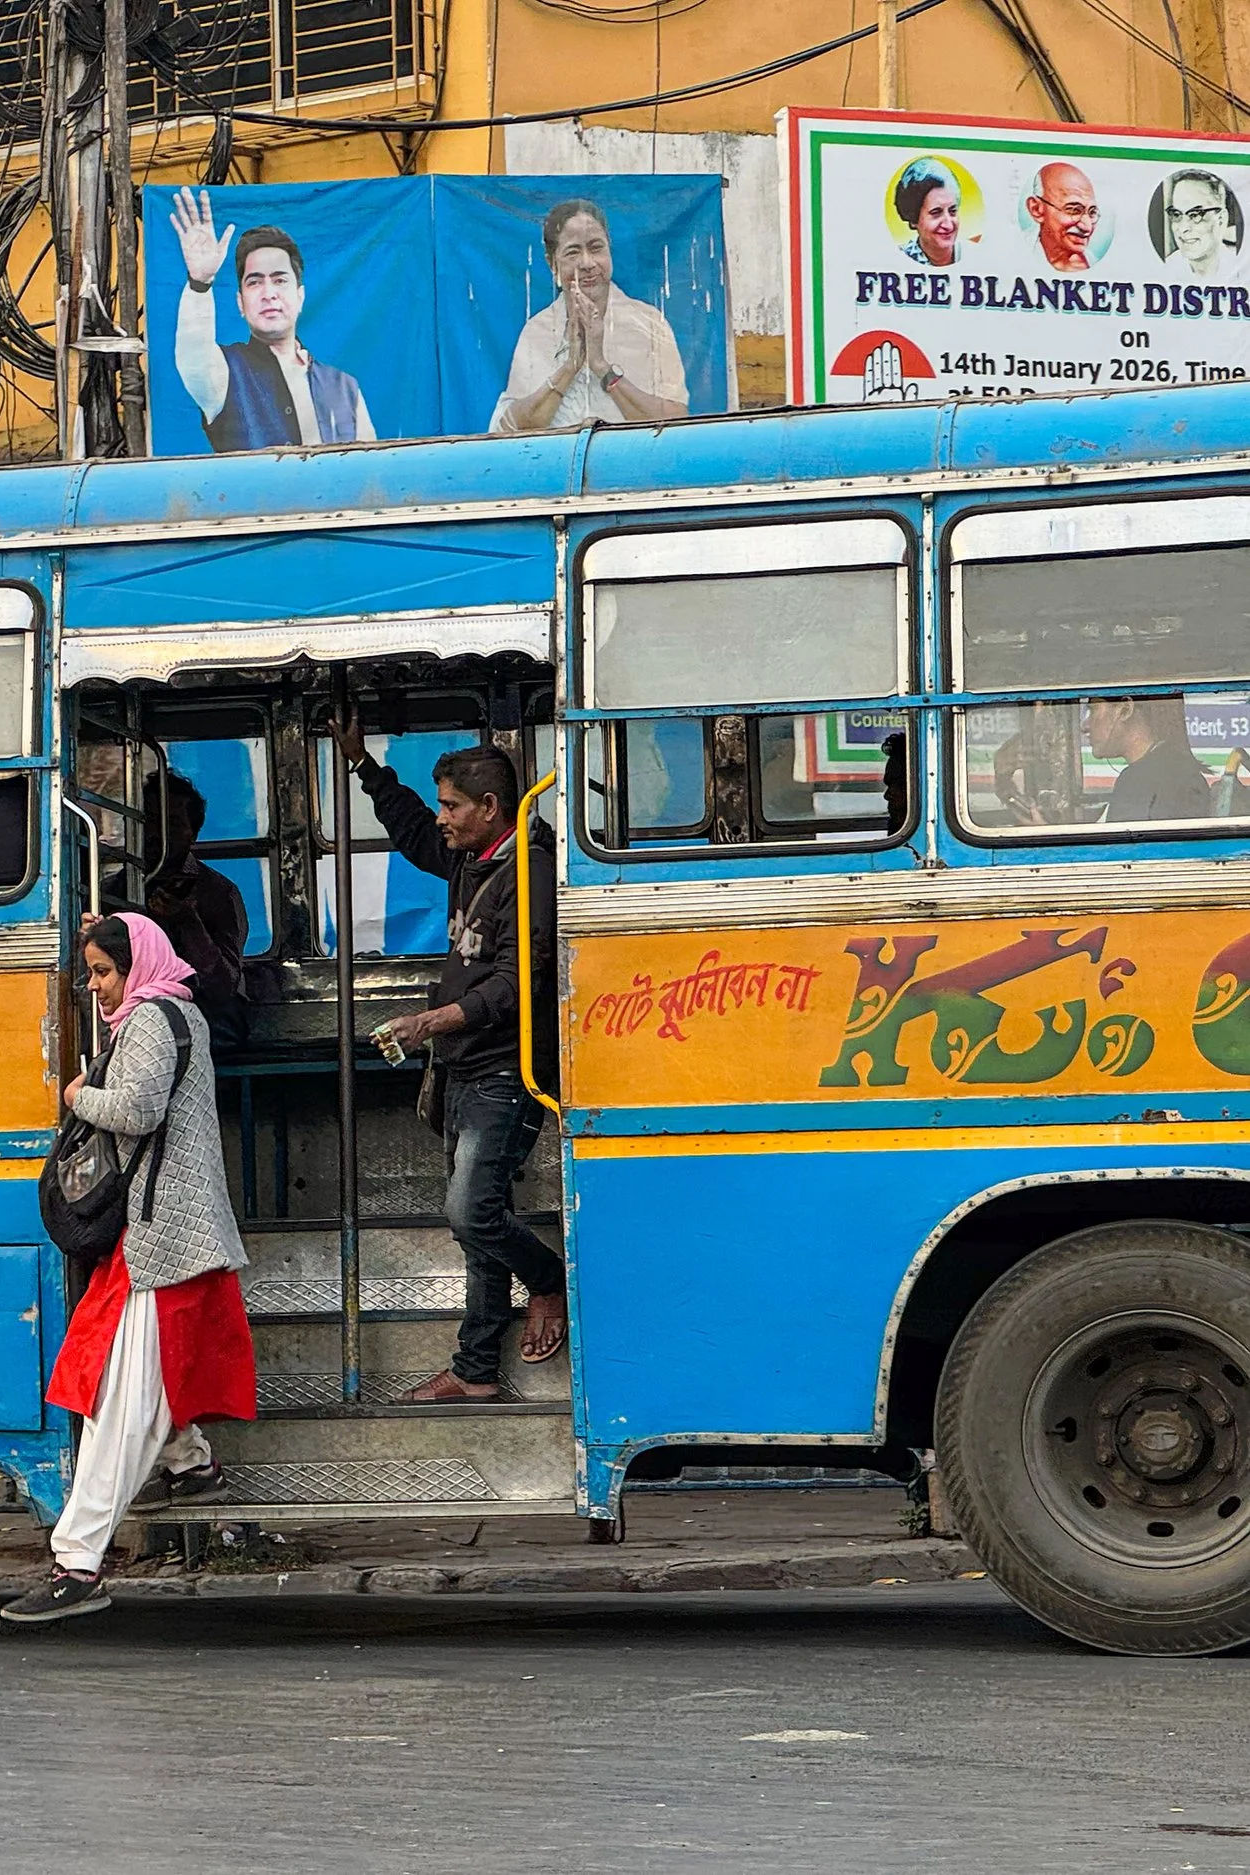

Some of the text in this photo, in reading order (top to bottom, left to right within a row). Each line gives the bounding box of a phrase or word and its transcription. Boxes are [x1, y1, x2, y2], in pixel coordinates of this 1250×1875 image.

[855, 271, 951, 309] FREE
[960, 275, 1135, 316] BLANKET
[1120, 330, 1151, 348] on
[939, 352, 1247, 385] 14th January 2026, Time
